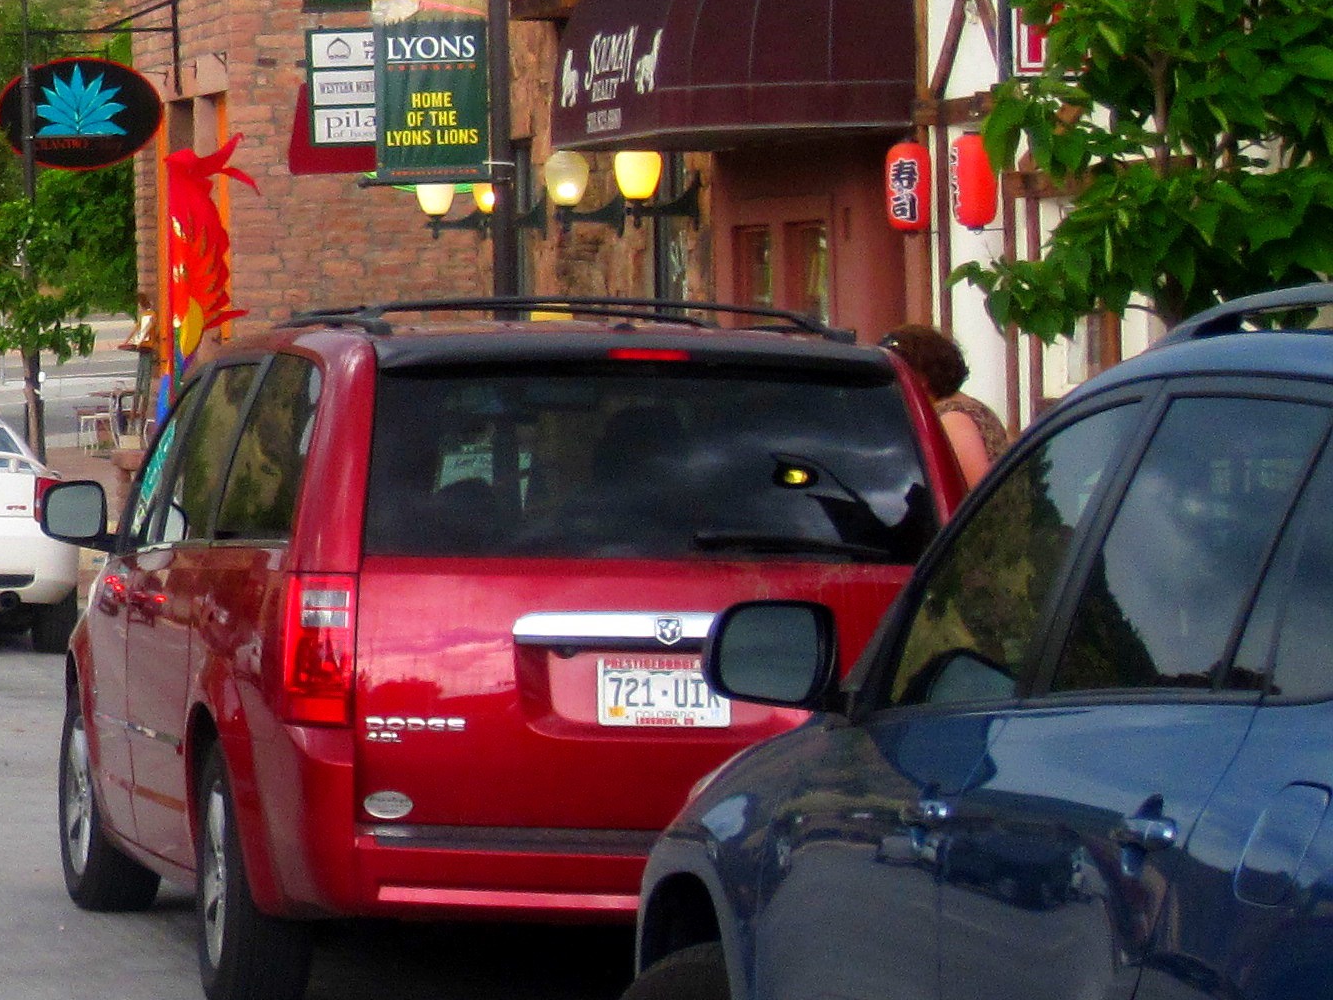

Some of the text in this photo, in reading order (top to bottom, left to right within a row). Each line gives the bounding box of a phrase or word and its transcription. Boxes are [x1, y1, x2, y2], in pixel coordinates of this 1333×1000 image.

[386, 34, 475, 60] LYONS
[411, 92, 452, 109] HOME
[407, 110, 457, 126] OF THE
[386, 129, 431, 146] LYONS
[436, 128, 478, 145] LIONS
[365, 716, 466, 731] DODGE
